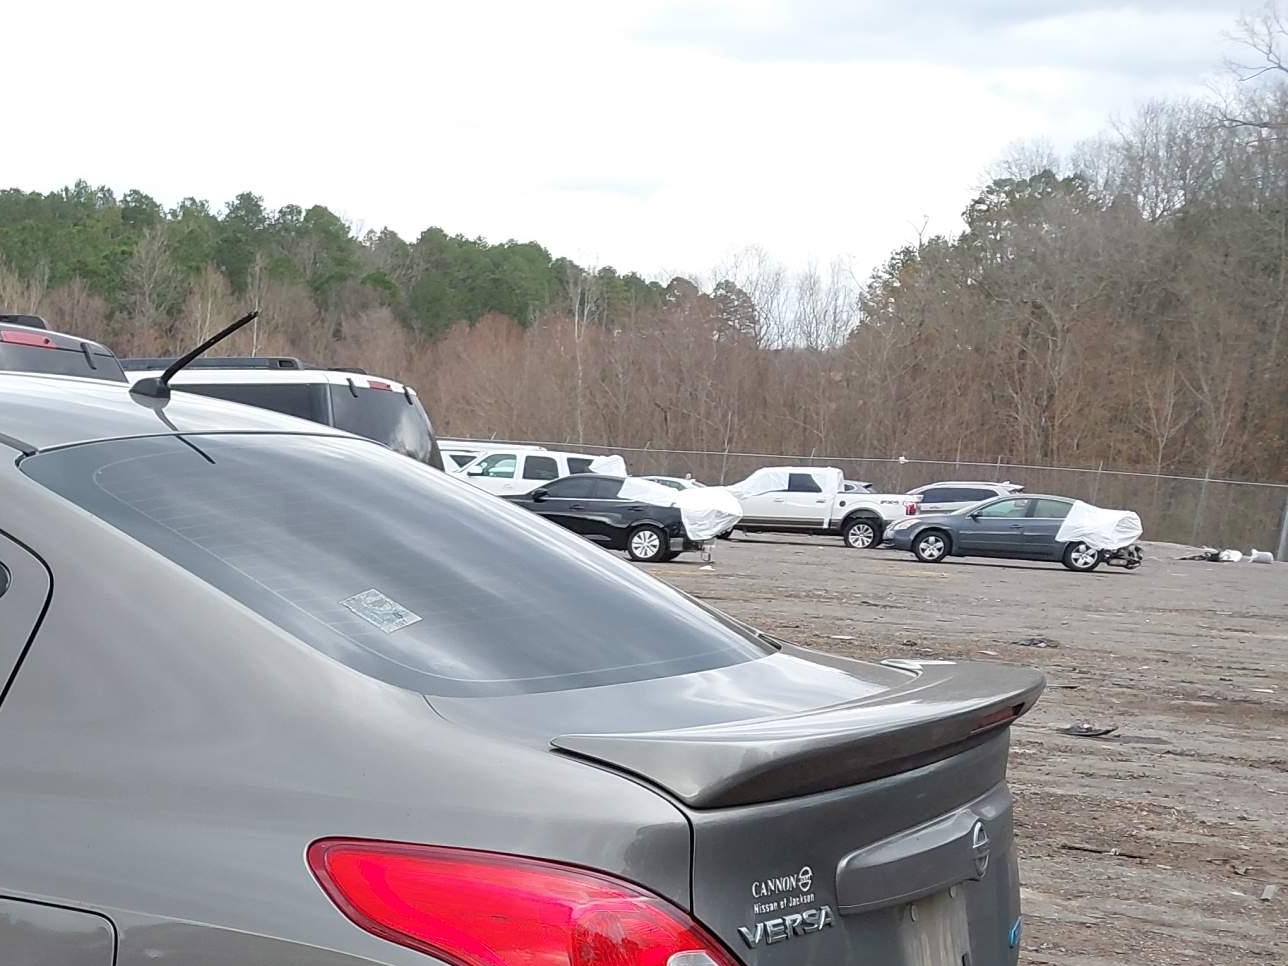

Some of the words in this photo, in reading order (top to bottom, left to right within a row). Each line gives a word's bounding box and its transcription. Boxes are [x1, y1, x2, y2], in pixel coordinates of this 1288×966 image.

[752, 874, 797, 897] CANNON
[753, 902, 778, 914] Nissan
[780, 897, 787, 909] of
[789, 893, 815, 907] Jackson
[737, 905, 834, 949] VERSA
